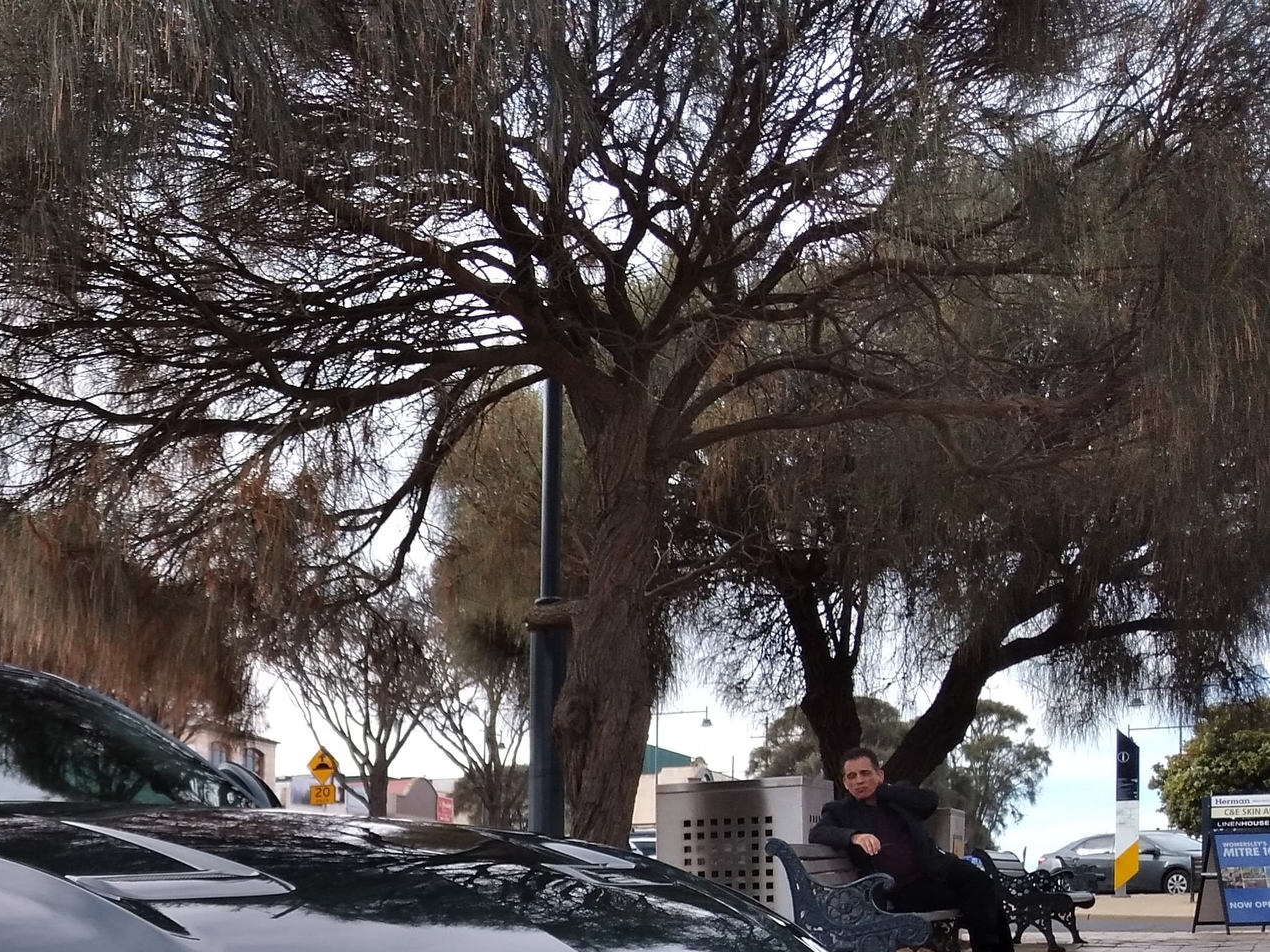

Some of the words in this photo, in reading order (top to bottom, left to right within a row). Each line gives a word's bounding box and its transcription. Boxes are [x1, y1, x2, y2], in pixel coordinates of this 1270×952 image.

[314, 787, 330, 798] 20
[1224, 808, 1240, 816] C&E
[1242, 808, 1261, 816] SKIN
[1217, 820, 1270, 828] LINENHOUSE
[1223, 847, 1260, 857] MITRE
[1229, 901, 1252, 909] NOW
